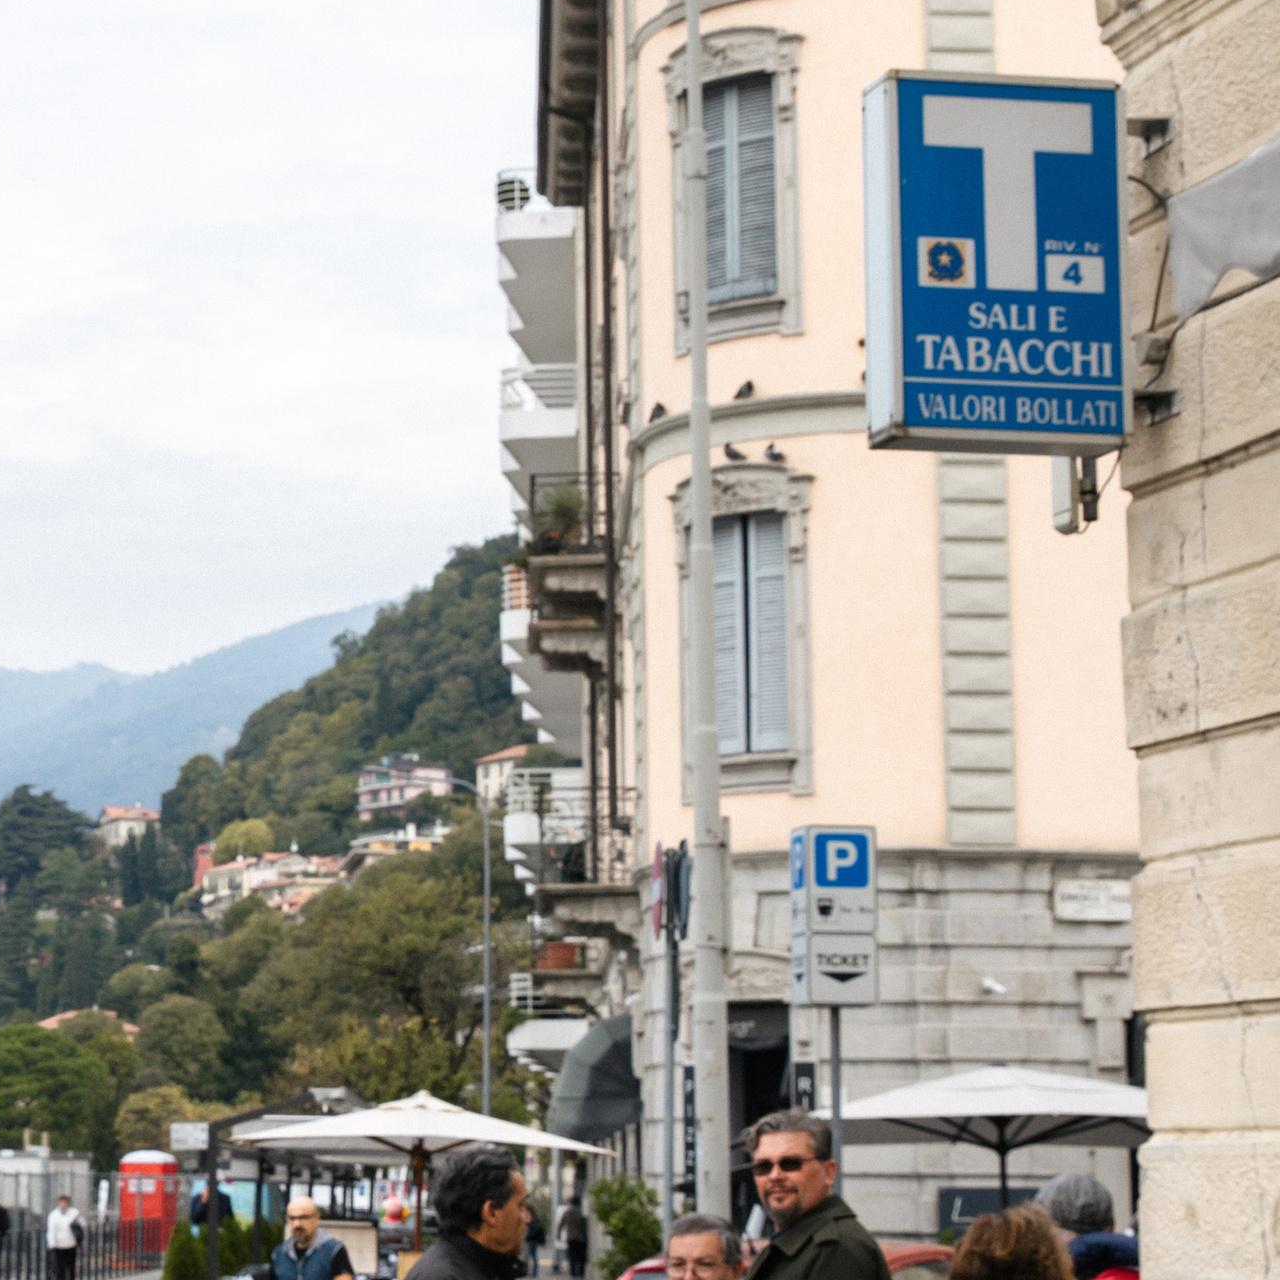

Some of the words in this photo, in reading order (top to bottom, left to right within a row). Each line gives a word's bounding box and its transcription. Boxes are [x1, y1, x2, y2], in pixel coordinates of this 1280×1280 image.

[923, 94, 1093, 292] T
[1063, 261, 1083, 286] 4
[968, 301, 1036, 331] SALI
[1048, 305, 1068, 333] E
[916, 333, 1113, 378] TABACCHI
[918, 393, 1006, 422] VALORI
[1016, 396, 1117, 427] BOLLATI
[825, 840, 858, 881] P
[817, 952, 869, 967] TICKET
